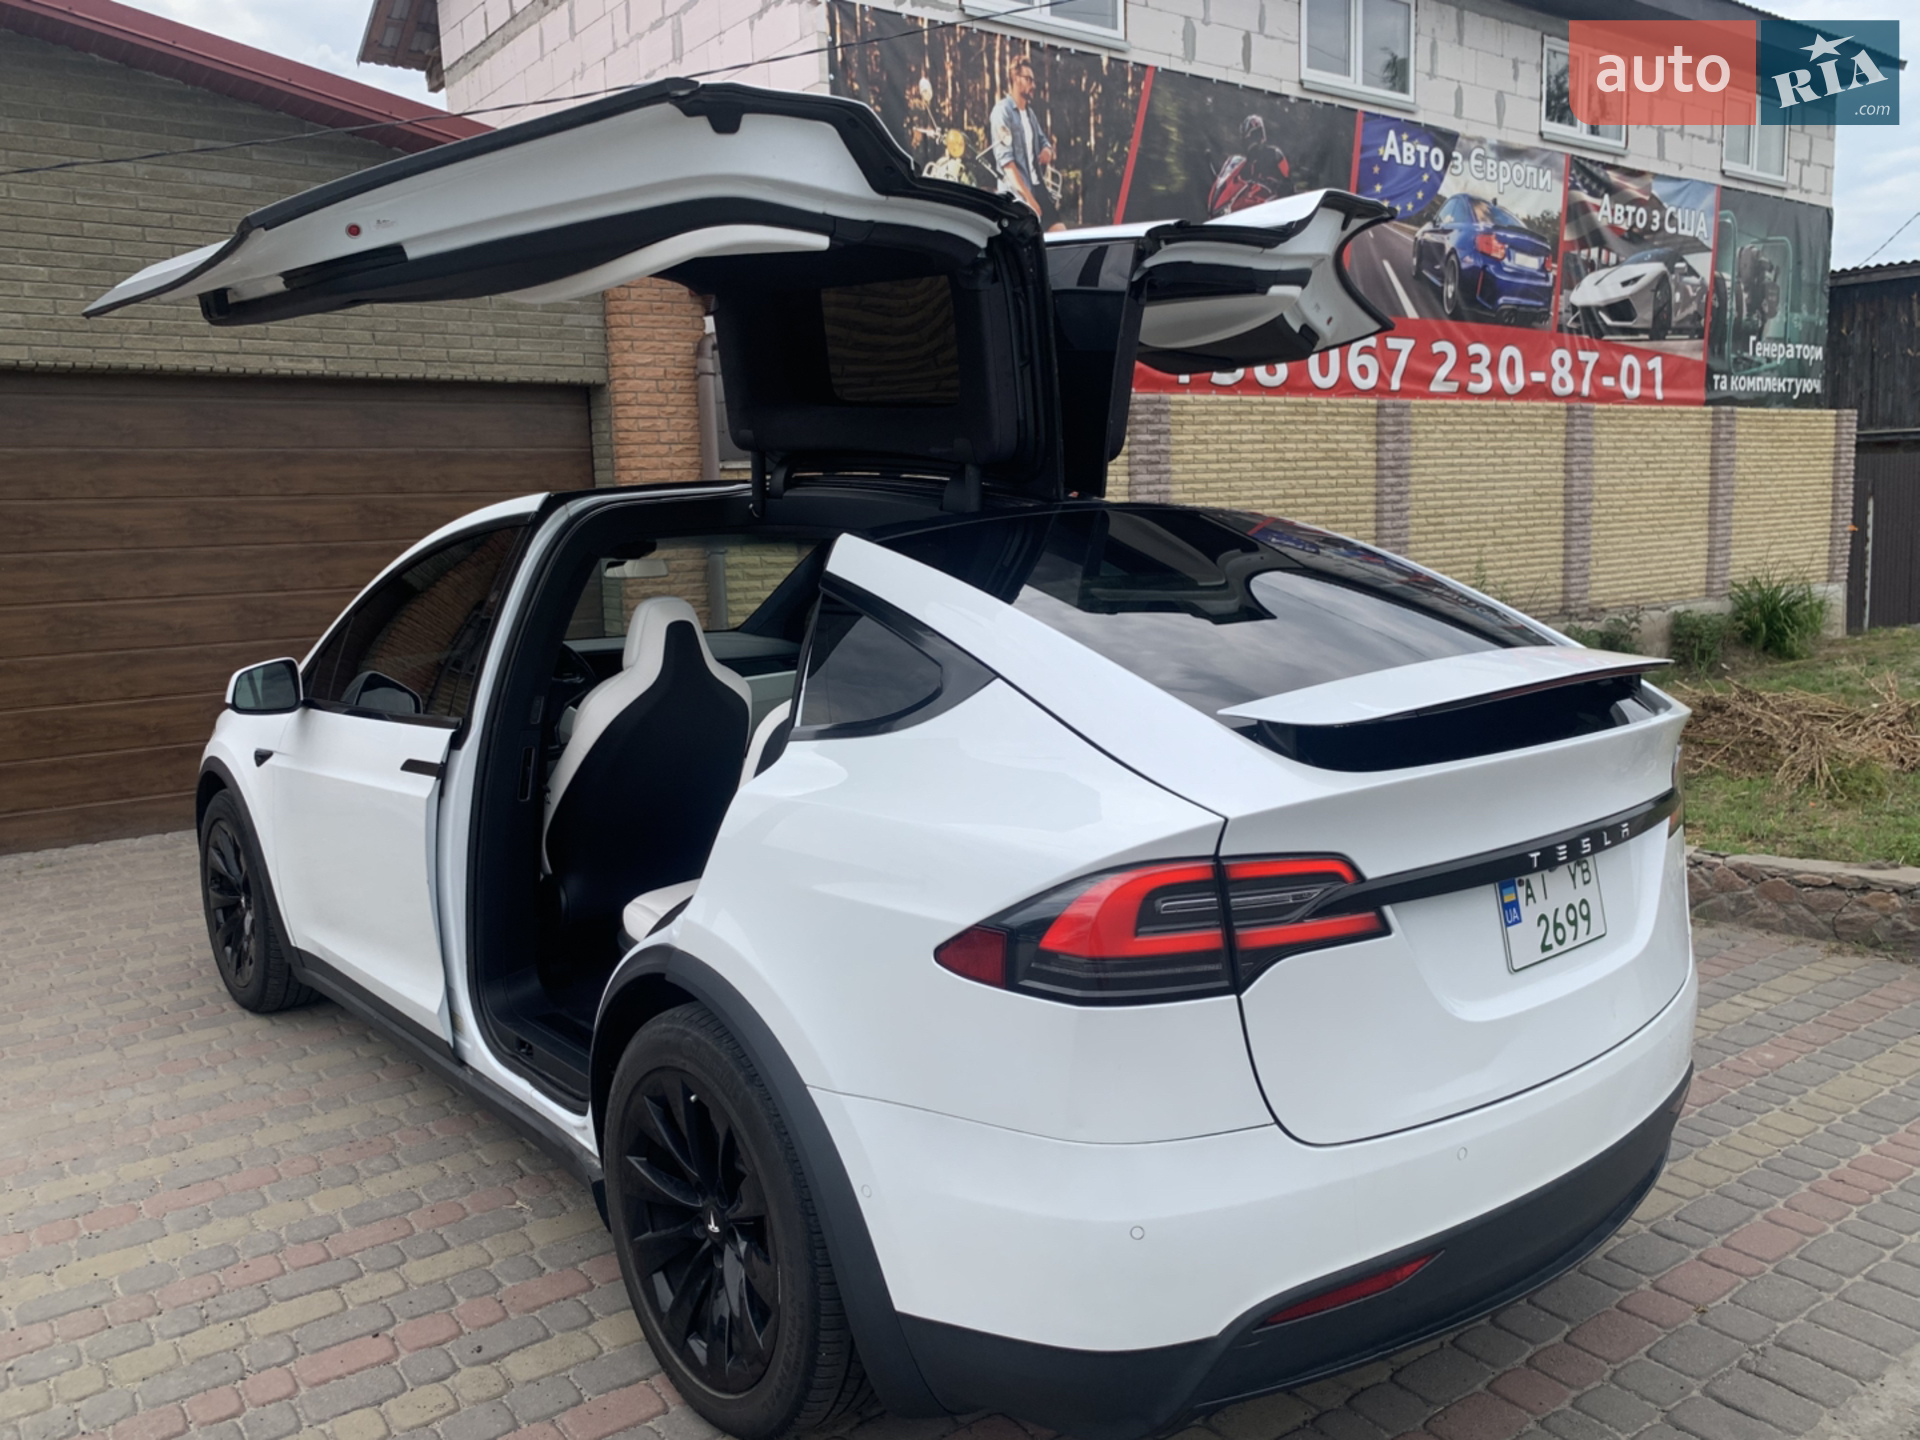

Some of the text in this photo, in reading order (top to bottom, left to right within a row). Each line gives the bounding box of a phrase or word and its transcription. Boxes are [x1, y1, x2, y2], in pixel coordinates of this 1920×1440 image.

[1382, 129, 1553, 194] Авто з Європи
[1597, 193, 1709, 239] Авто з США
[1307, 334, 1416, 392] 067
[1428, 340, 1664, 401] 230-87-01
[1748, 336, 1823, 366] Генератори
[1712, 373, 1728, 391] та
[1528, 823, 1630, 868] TESLA
[1505, 908, 1519, 923] UA
[1537, 898, 1591, 954] 2699
